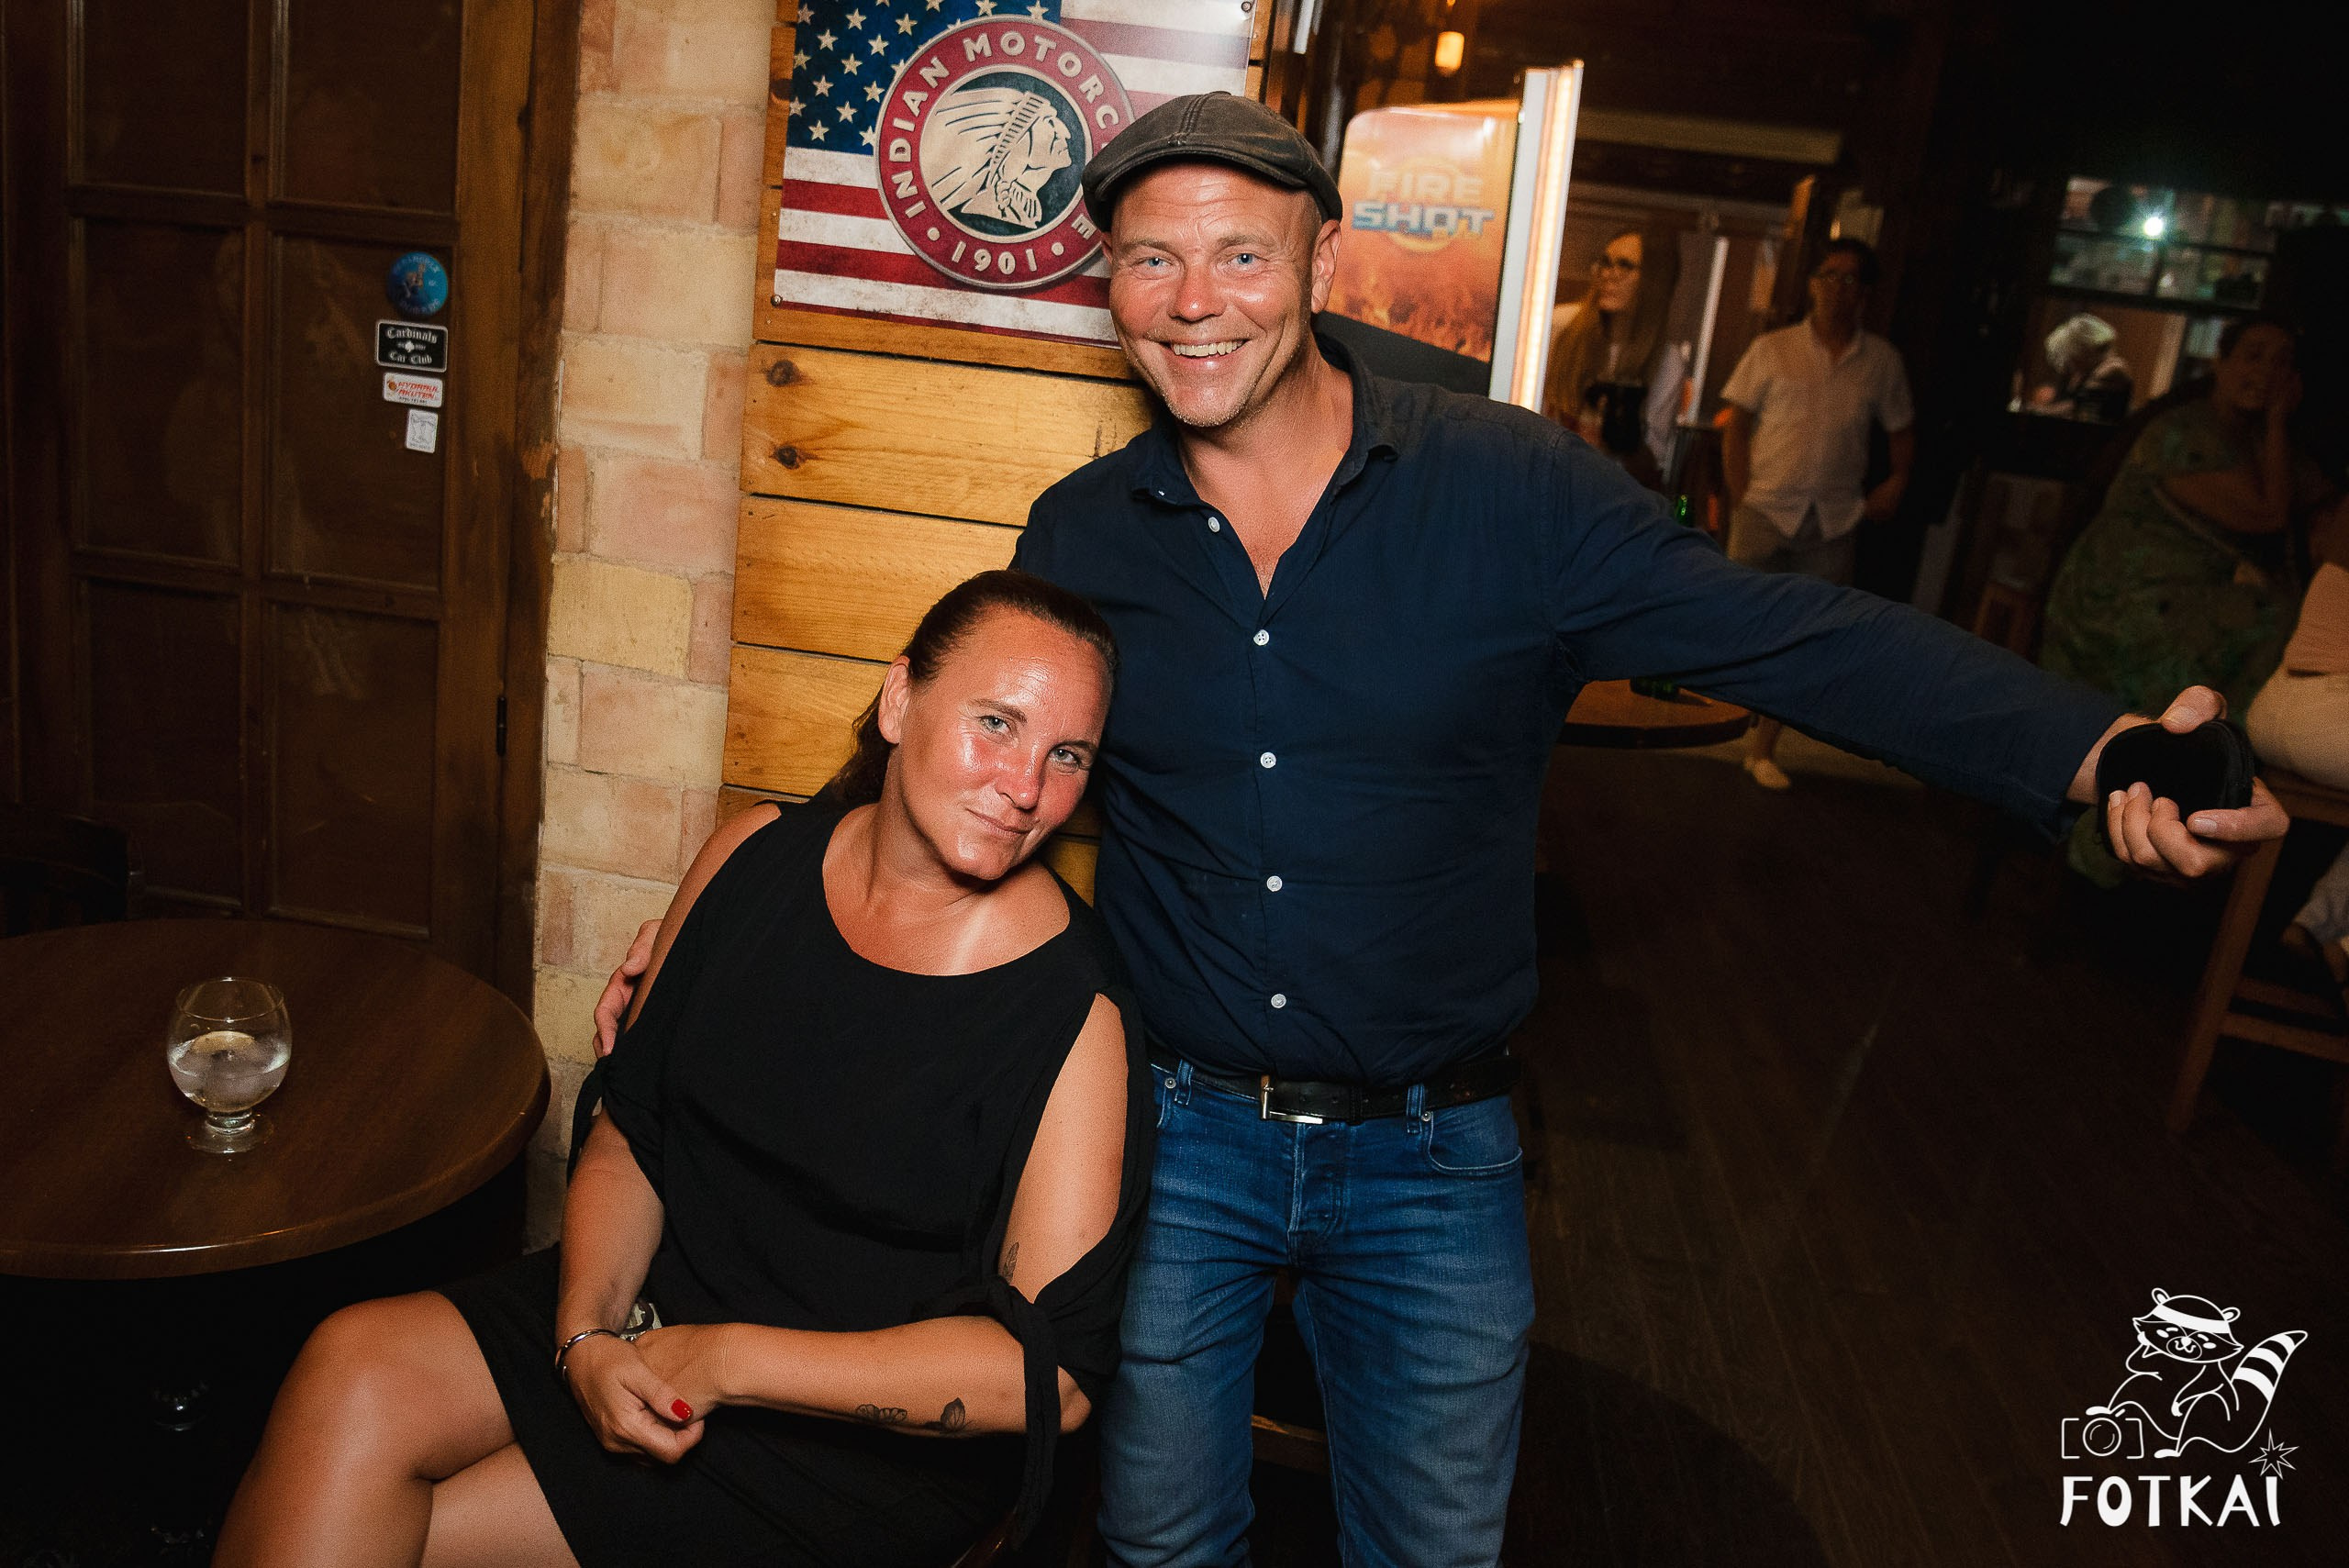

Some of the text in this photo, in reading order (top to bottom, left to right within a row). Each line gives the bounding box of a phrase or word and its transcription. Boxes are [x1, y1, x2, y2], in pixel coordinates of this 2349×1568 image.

[889, 30, 1119, 240] INDIAN MOTORCE
[1367, 171, 1484, 201] FIRE
[1352, 199, 1495, 237] SHOT
[952, 240, 1039, 275] 1901
[386, 327, 438, 344] Cardinals
[390, 350, 432, 364] Car Club
